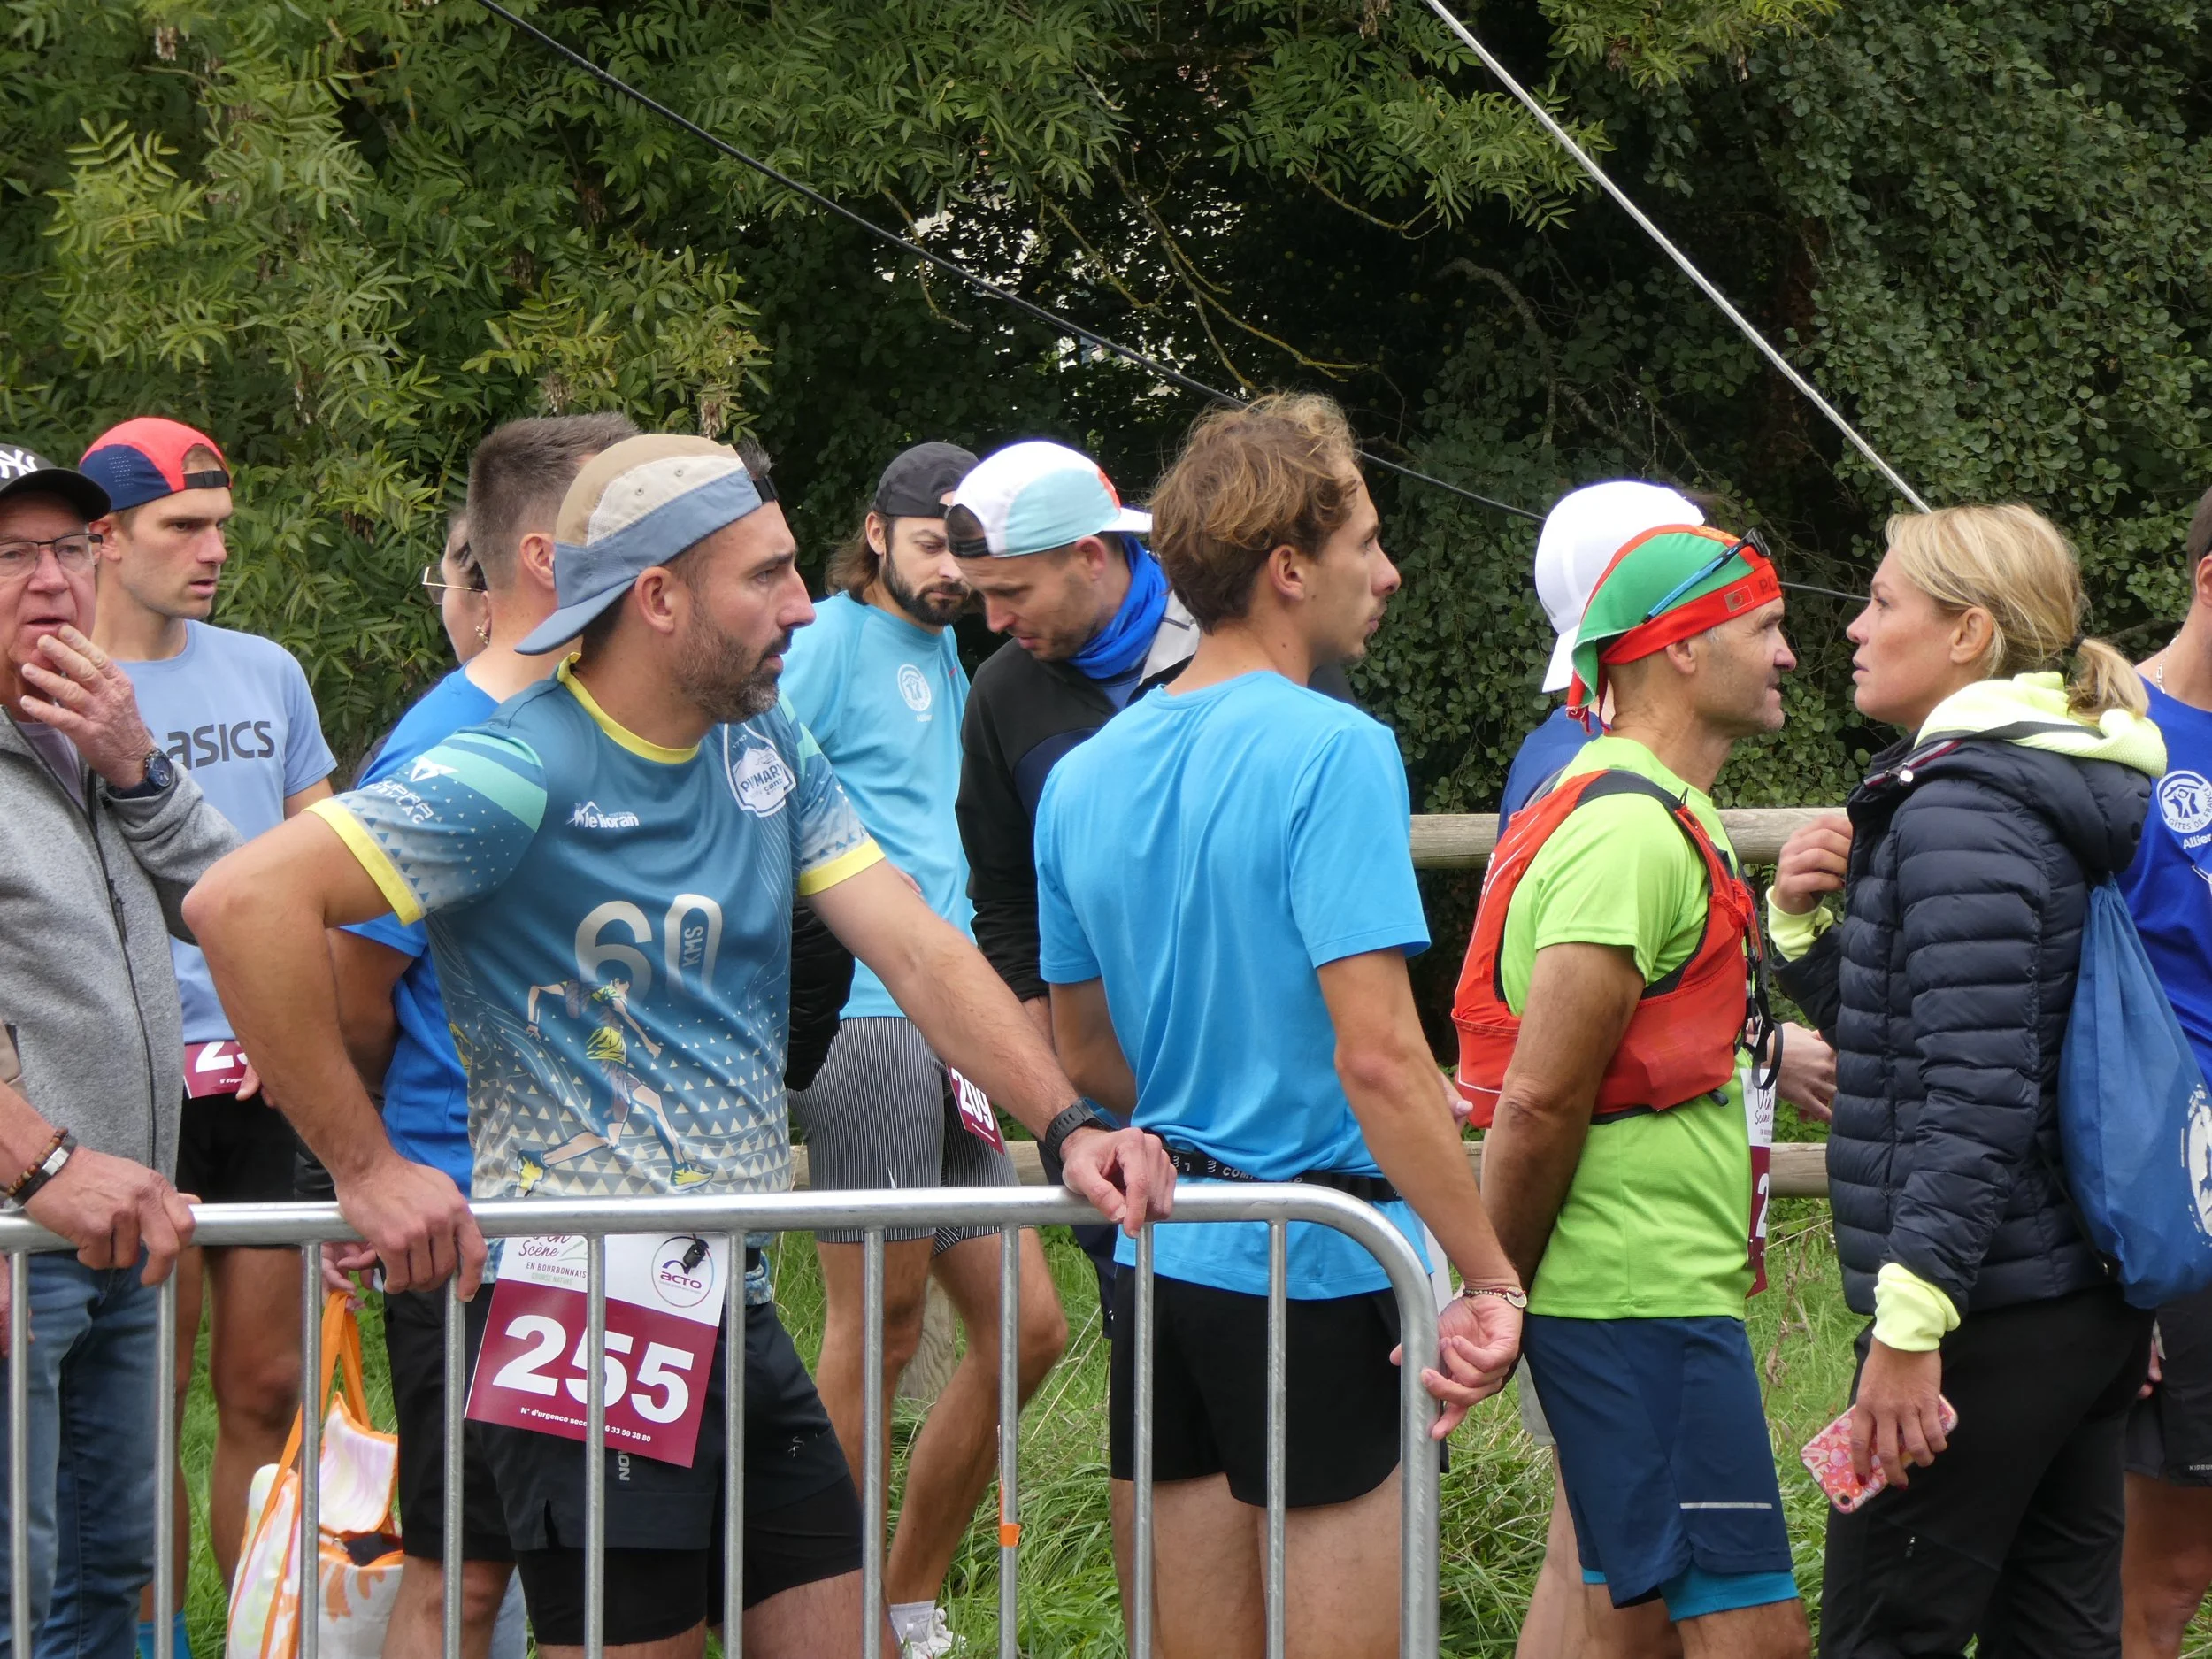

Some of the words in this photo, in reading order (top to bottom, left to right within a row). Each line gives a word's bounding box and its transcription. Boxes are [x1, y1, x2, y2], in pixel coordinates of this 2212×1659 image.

[597, 811, 640, 828] lioran
[2194, 818, 2205, 829] DE
[2183, 833, 2212, 849] Allier
[575, 893, 723, 1005] 60
[681, 926, 704, 968] KMS
[518, 1240, 560, 1257] Scène
[526, 1261, 535, 1271] EN
[537, 1263, 588, 1279] BOURBONNAIS
[492, 1313, 695, 1425] 255
[569, 1417, 588, 1427] seco
[611, 1426, 621, 1435] 33
[621, 1429, 632, 1438] 59
[632, 1432, 641, 1440] 38
